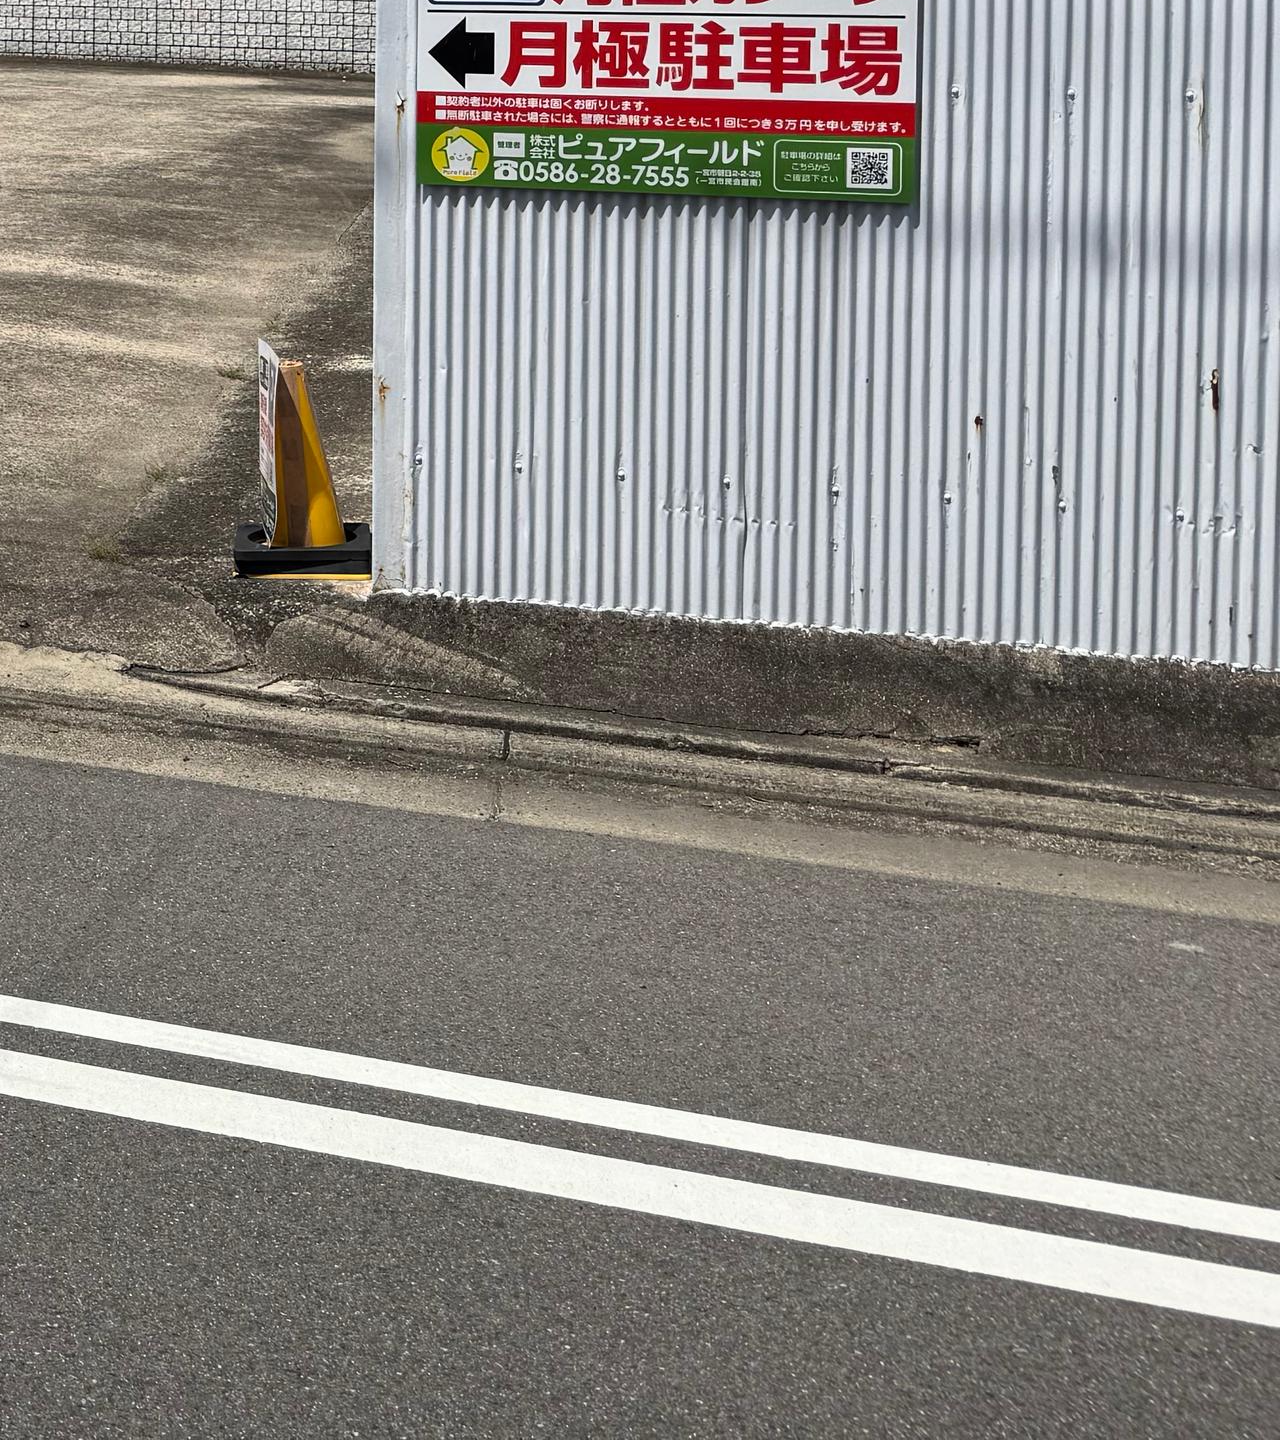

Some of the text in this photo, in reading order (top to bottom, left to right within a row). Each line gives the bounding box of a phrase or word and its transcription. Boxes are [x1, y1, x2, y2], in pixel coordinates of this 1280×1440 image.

[500, 20, 903, 96] 月極駐車場
[558, 133, 765, 167] ピュアフィールド
[519, 161, 689, 187] 0586-28-7555
